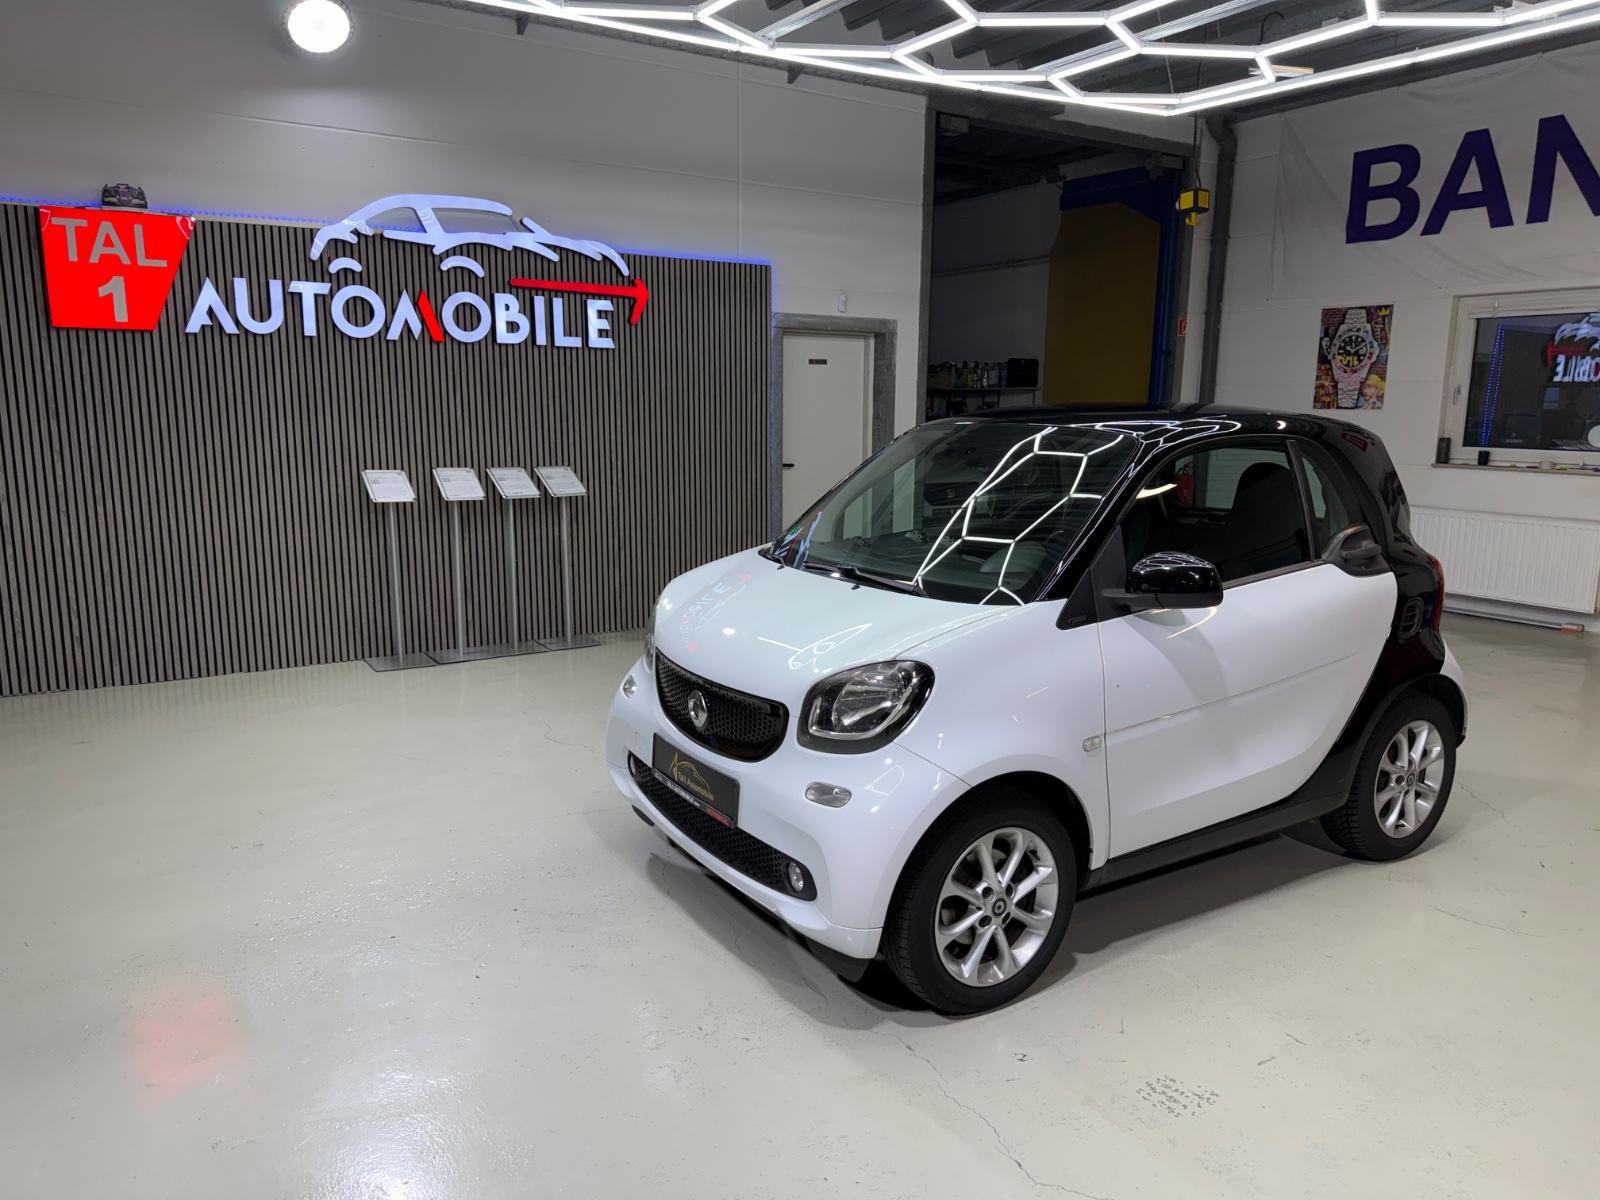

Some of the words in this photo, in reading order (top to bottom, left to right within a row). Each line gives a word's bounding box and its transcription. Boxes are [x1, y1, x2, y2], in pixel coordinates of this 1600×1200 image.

[1346, 113, 1600, 244] BAN
[51, 217, 168, 267] TAL
[98, 276, 129, 323] 1
[185, 276, 615, 349] AUTOMOBILE
